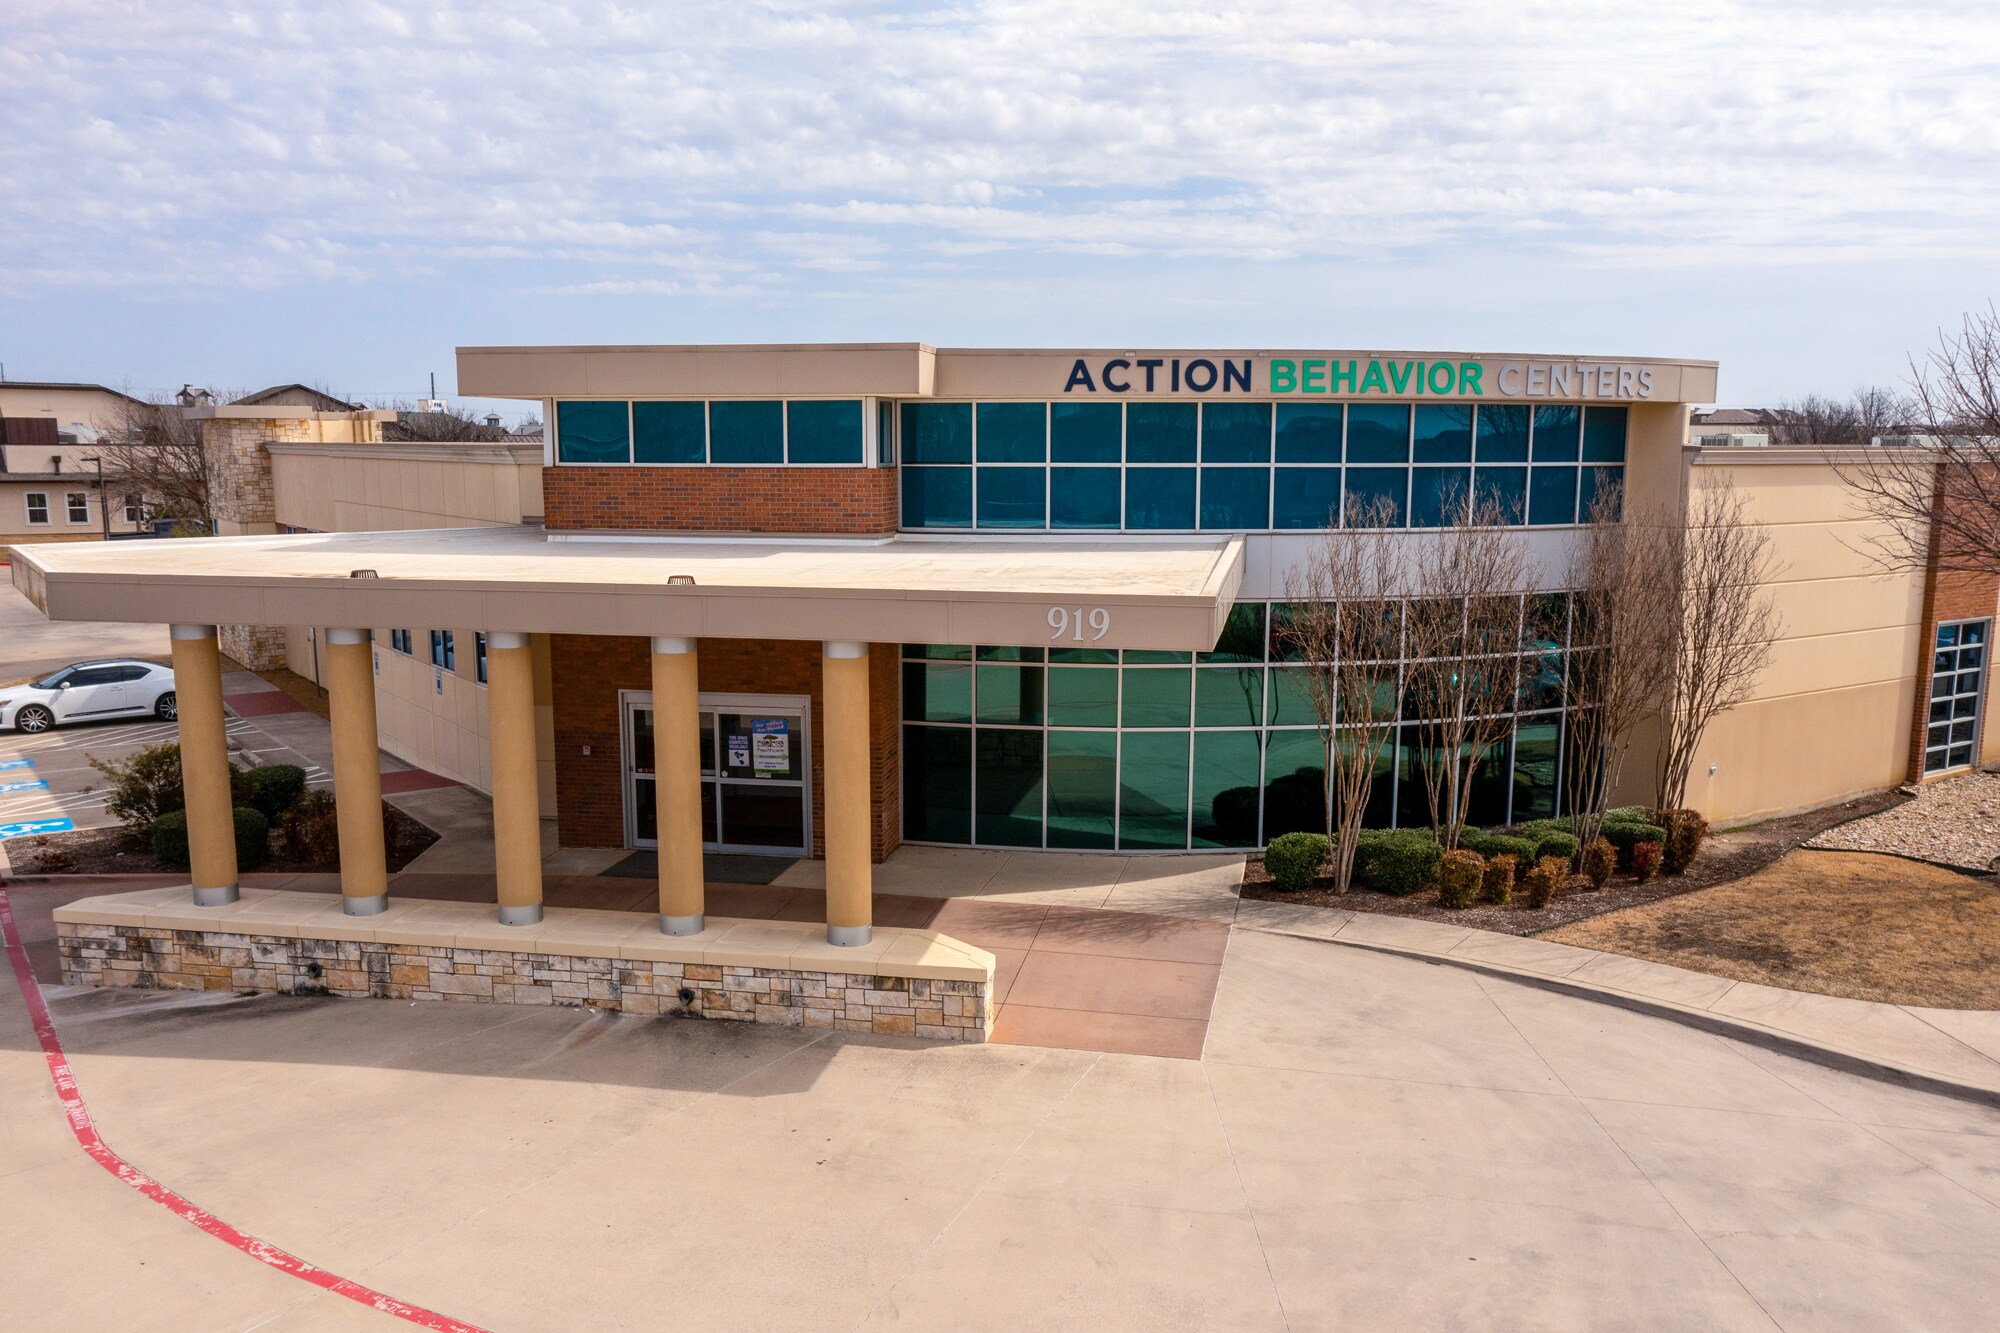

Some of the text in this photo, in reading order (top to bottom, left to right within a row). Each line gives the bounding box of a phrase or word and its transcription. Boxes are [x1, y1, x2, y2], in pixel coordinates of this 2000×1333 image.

[1063, 359, 1654, 398] ACTION BEHAVIOR CENTERS
[1047, 606, 1110, 641] 919
